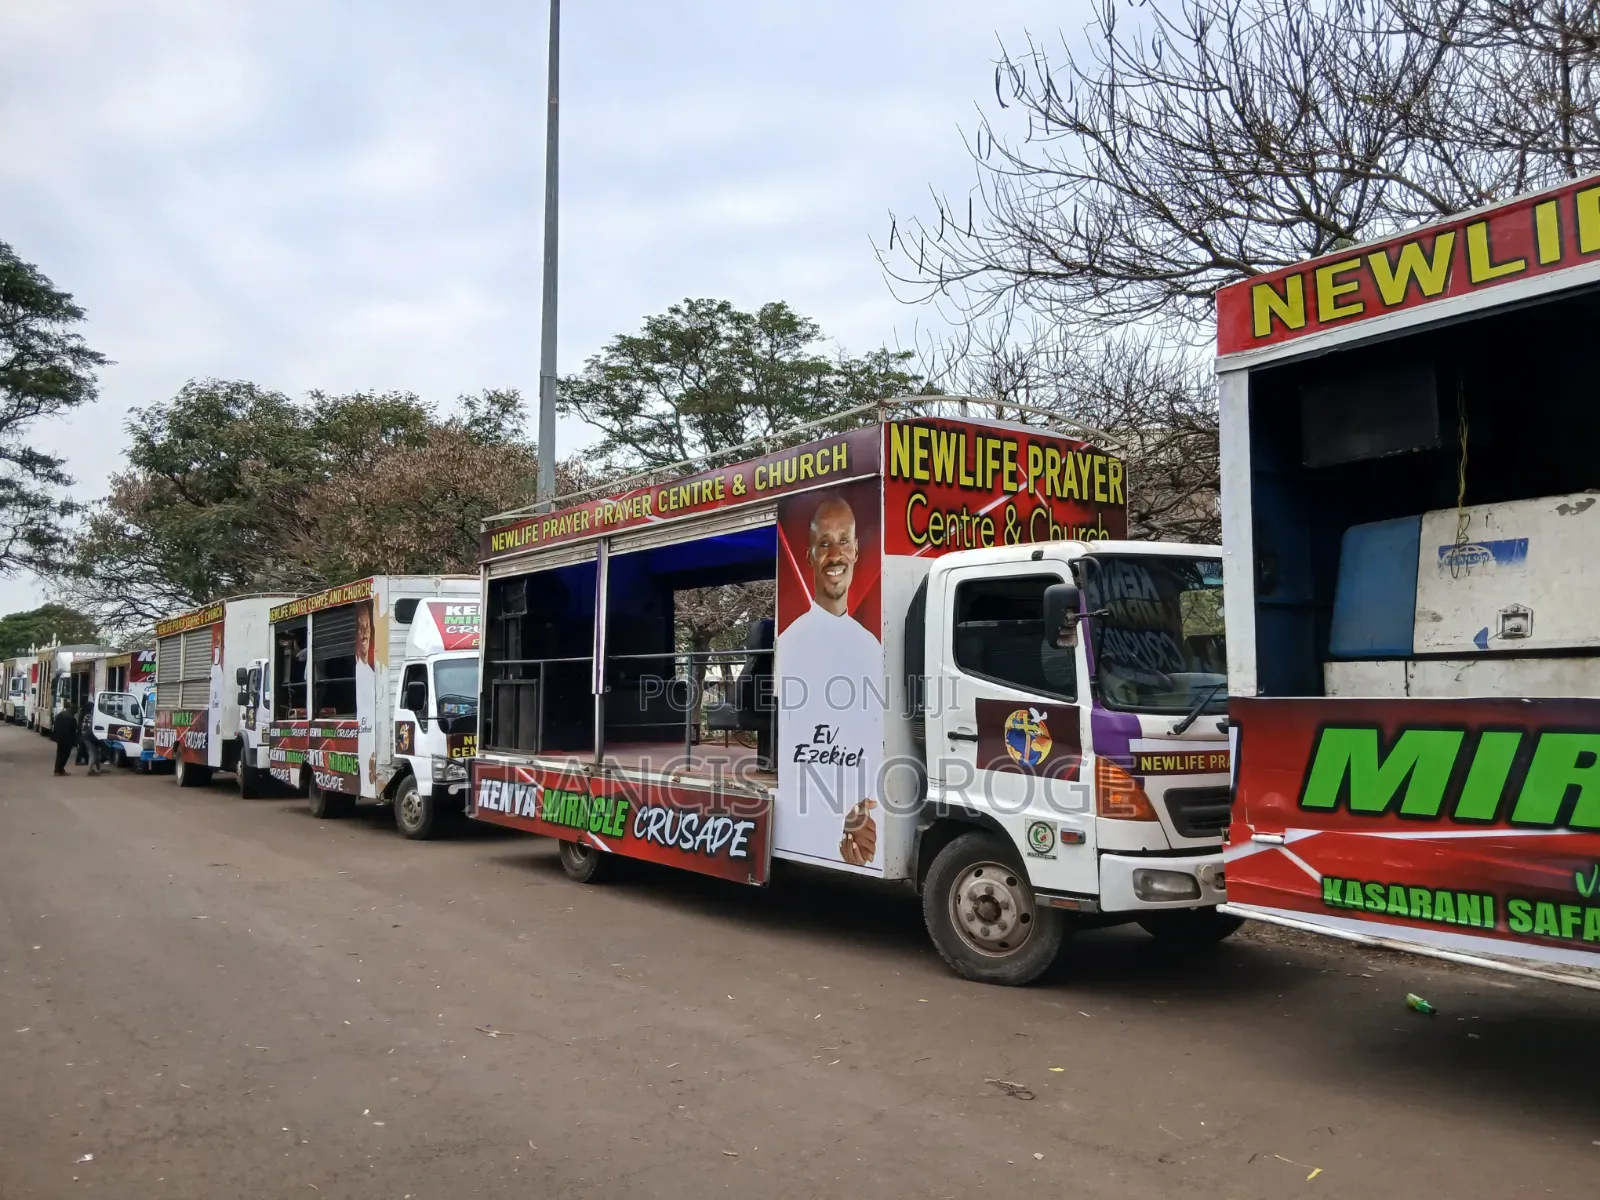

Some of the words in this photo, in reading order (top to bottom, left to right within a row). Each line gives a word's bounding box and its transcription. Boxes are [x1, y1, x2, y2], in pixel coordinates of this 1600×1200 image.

[890, 422, 1018, 492] NEWLIFE
[1028, 444, 1124, 505] PRAYER
[491, 523, 539, 552] NEWLIFE
[542, 513, 590, 541] PRAYER
[594, 494, 653, 526] PRAYER
[657, 475, 726, 514] CENTRE
[731, 473, 746, 496] &
[754, 442, 849, 490] CHURCH
[906, 494, 995, 548] Centre
[1004, 504, 1022, 544] &
[289, 599, 307, 616] PRAYER
[329, 588, 342, 604] AND
[343, 581, 371, 600] CHURCH
[137, 650, 156, 662] K
[336, 728, 359, 739] CRUSADE
[813, 723, 840, 744] Ev
[793, 743, 865, 768] Ezekiel
[1141, 755, 1206, 771] NEWLIFE
[1301, 728, 1600, 828] MIR
[476, 777, 537, 819] KENYA
[541, 787, 630, 838] MIRACLE
[632, 804, 757, 858] CRUSADE
[1575, 863, 1600, 898] V
[1322, 876, 1496, 929] KASARANI
